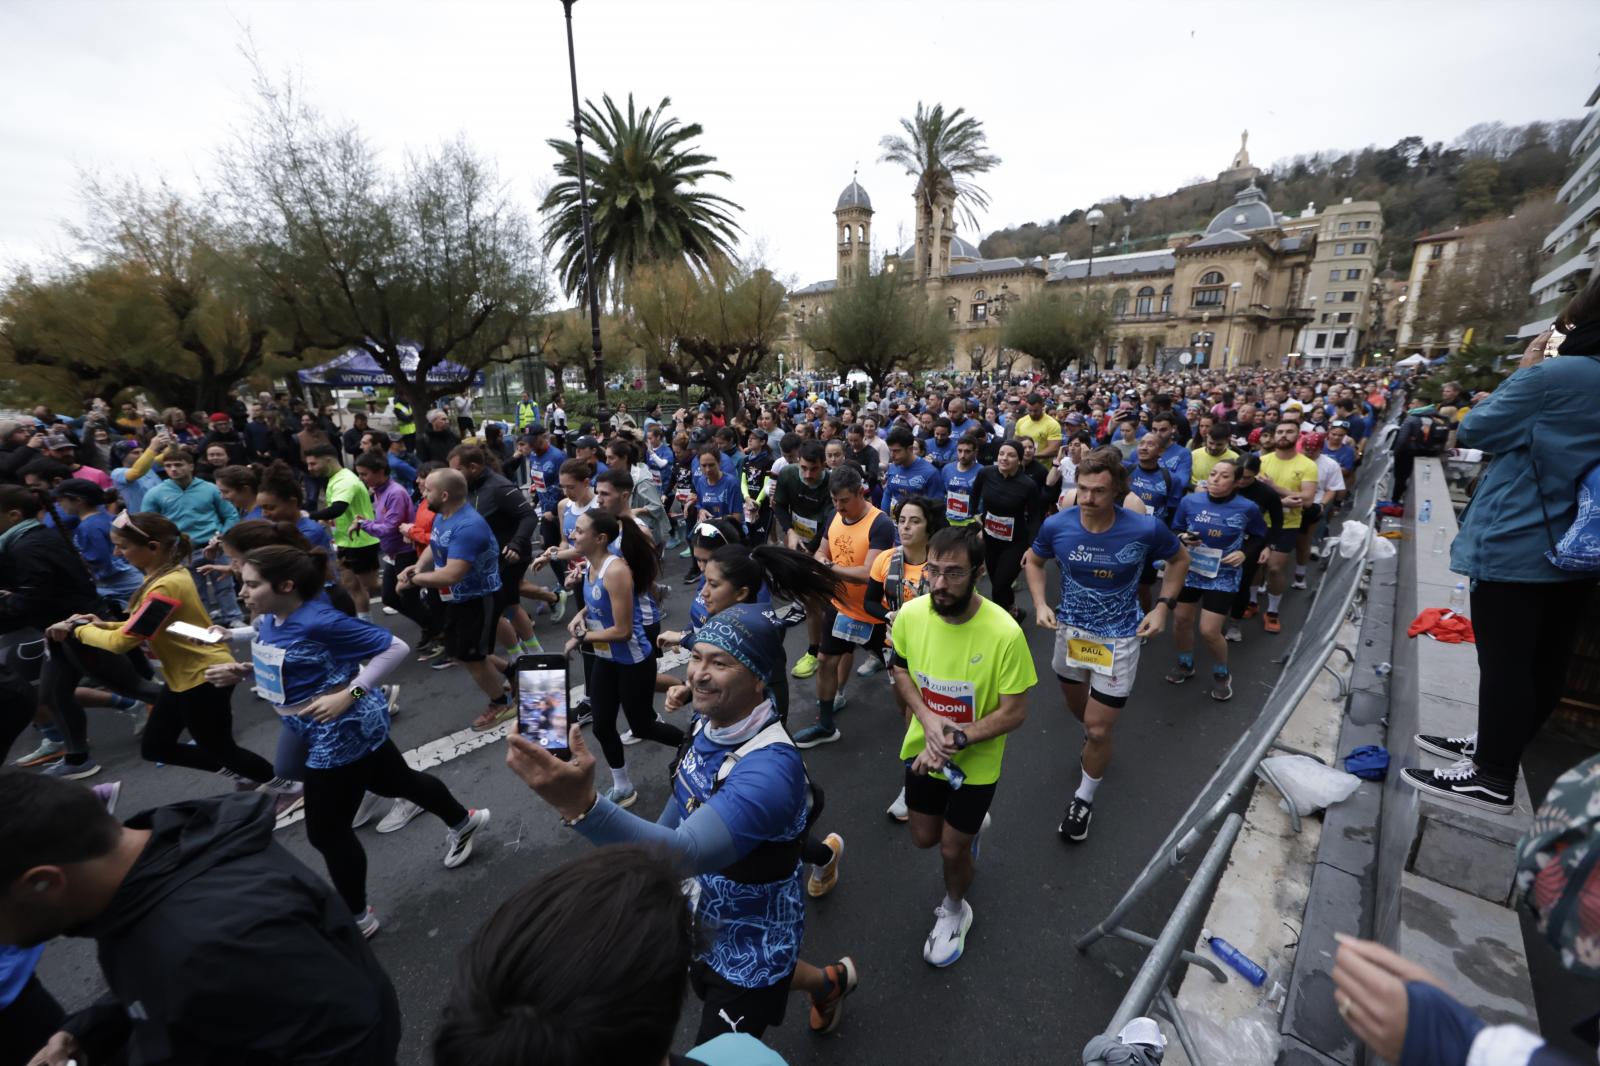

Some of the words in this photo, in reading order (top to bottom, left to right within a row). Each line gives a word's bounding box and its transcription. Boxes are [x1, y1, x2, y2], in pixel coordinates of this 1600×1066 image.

[1092, 568, 1115, 579] 10k
[1081, 646, 1104, 656] PAUL
[931, 682, 962, 692] ZURICH
